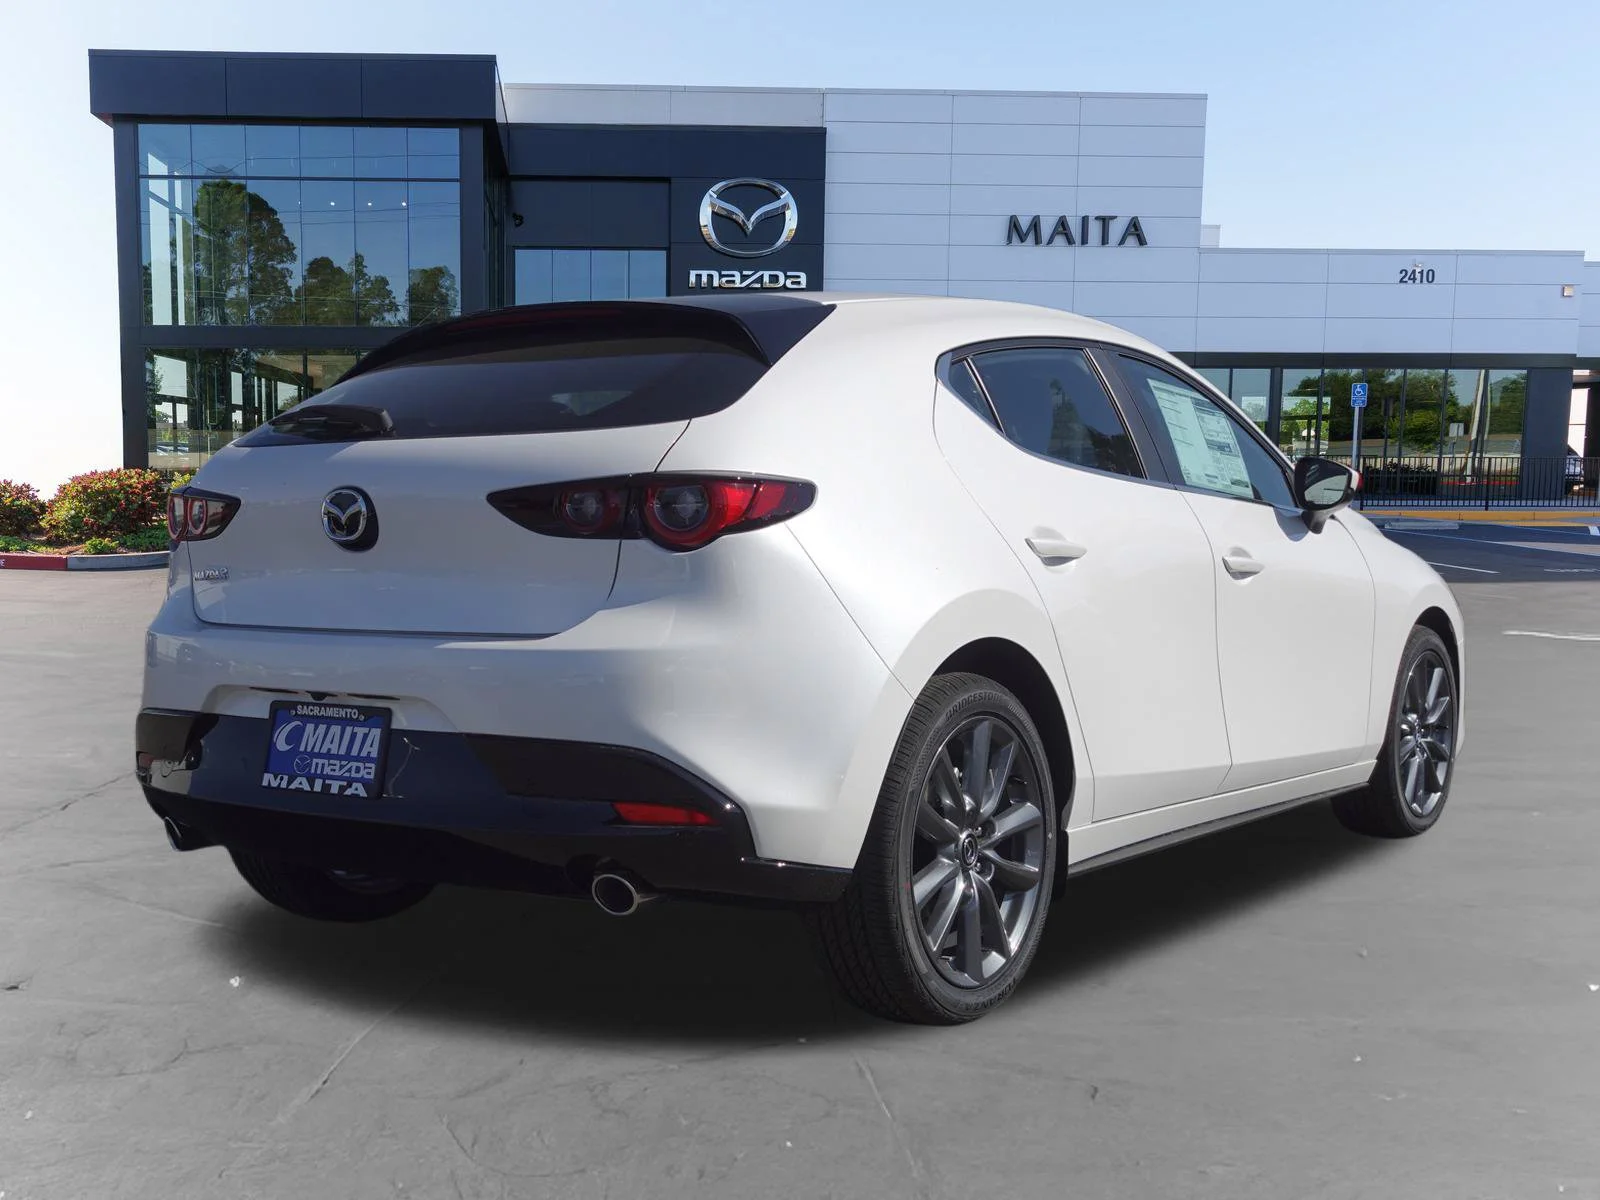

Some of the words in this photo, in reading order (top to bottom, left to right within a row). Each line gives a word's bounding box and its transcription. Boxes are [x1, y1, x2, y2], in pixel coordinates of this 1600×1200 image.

[1006, 214, 1148, 246] MAITA
[1399, 269, 1435, 284] 2410
[296, 705, 359, 719] SACRAMENTO
[945, 691, 1001, 721] BRIDGESTON
[299, 723, 382, 758] MAITA
[261, 772, 368, 798] MAITA
